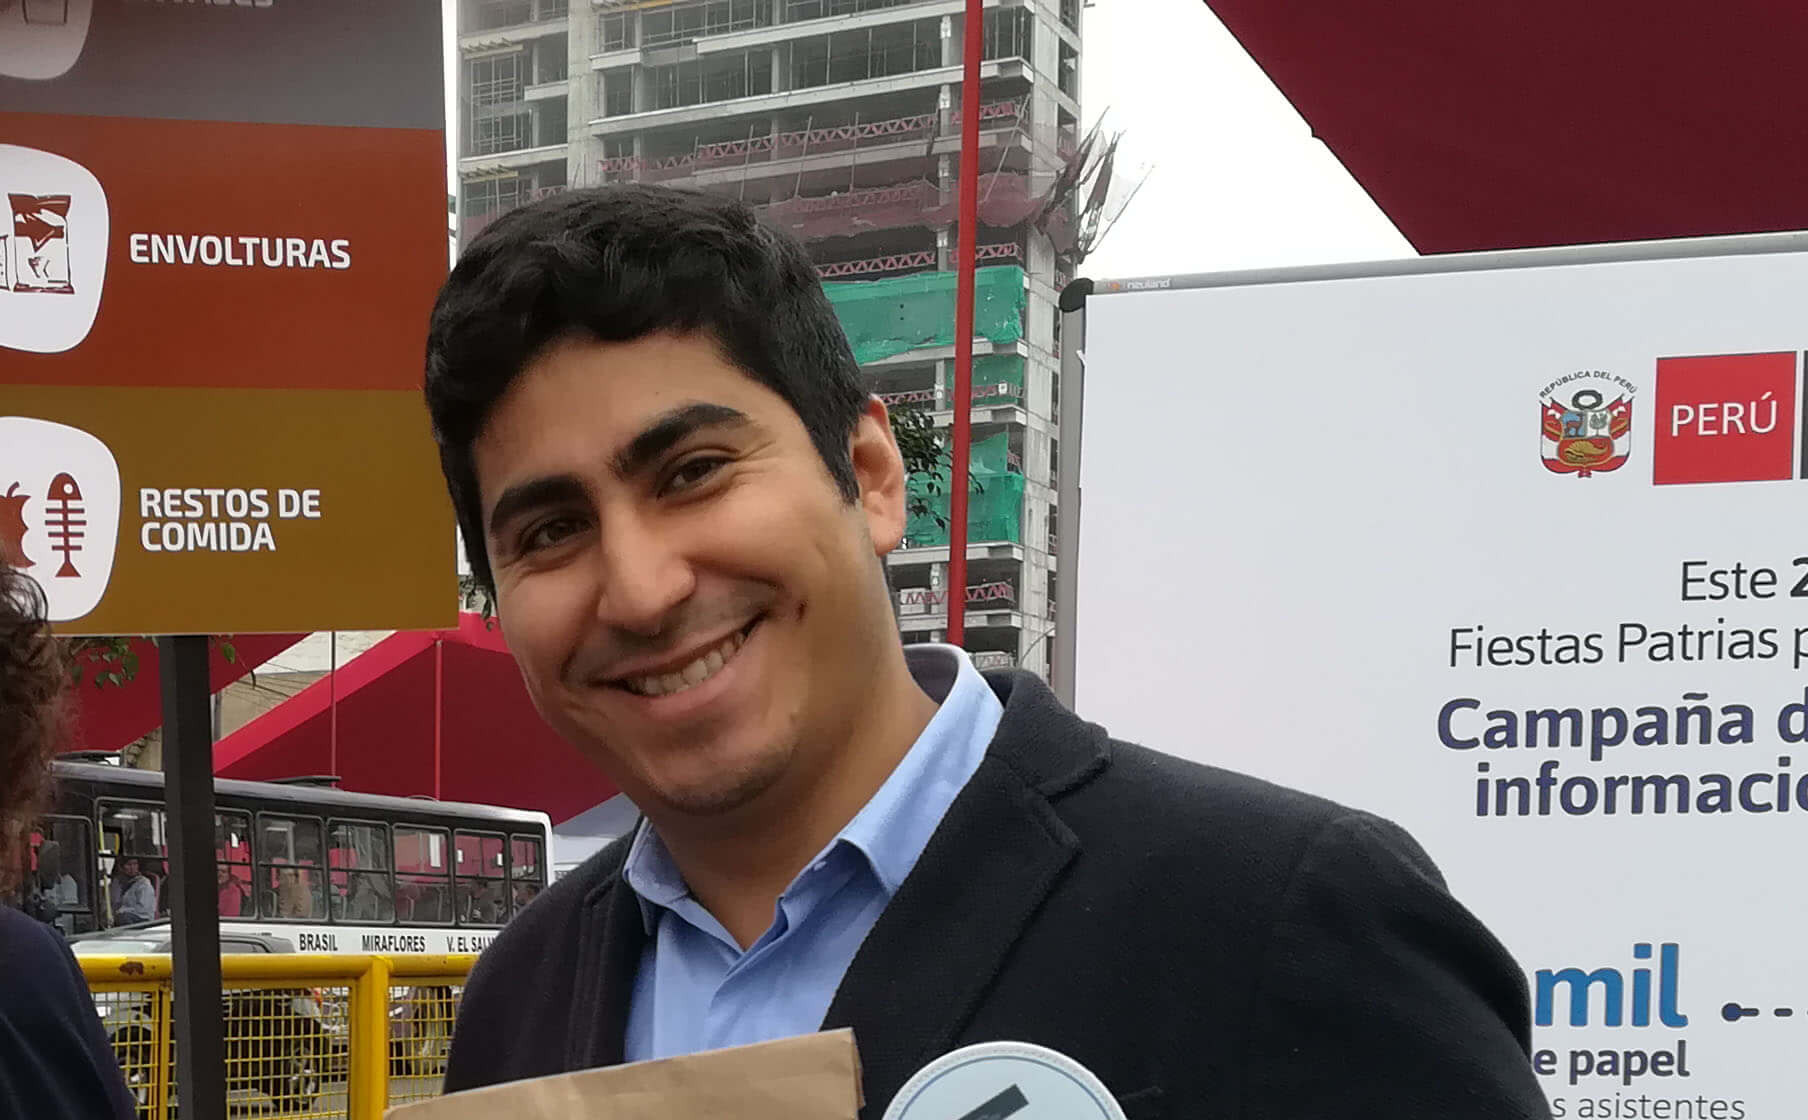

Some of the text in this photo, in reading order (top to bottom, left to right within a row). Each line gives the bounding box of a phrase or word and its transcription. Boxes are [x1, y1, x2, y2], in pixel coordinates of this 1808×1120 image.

[129, 233, 352, 269] ENVOLTURAS
[1539, 370, 1638, 398] REPÚBLICA DEL PERÚ
[1671, 391, 1777, 437] PERÚ
[139, 487, 322, 520] RESTOS DE
[140, 521, 277, 552] COMIDA
[1680, 560, 1778, 603] Este
[1449, 626, 1603, 668] Fiestas
[1617, 617, 1779, 663] Patrias
[1437, 692, 1755, 761] Campaña
[299, 933, 338, 951] BRASIL
[362, 934, 425, 952] MIRAFLORES
[446, 936, 455, 952] V.
[458, 936, 469, 952] EL
[1535, 942, 1689, 1028] mil
[1569, 1040, 1691, 1086] papel
[1578, 1092, 1746, 1120] asistentes
